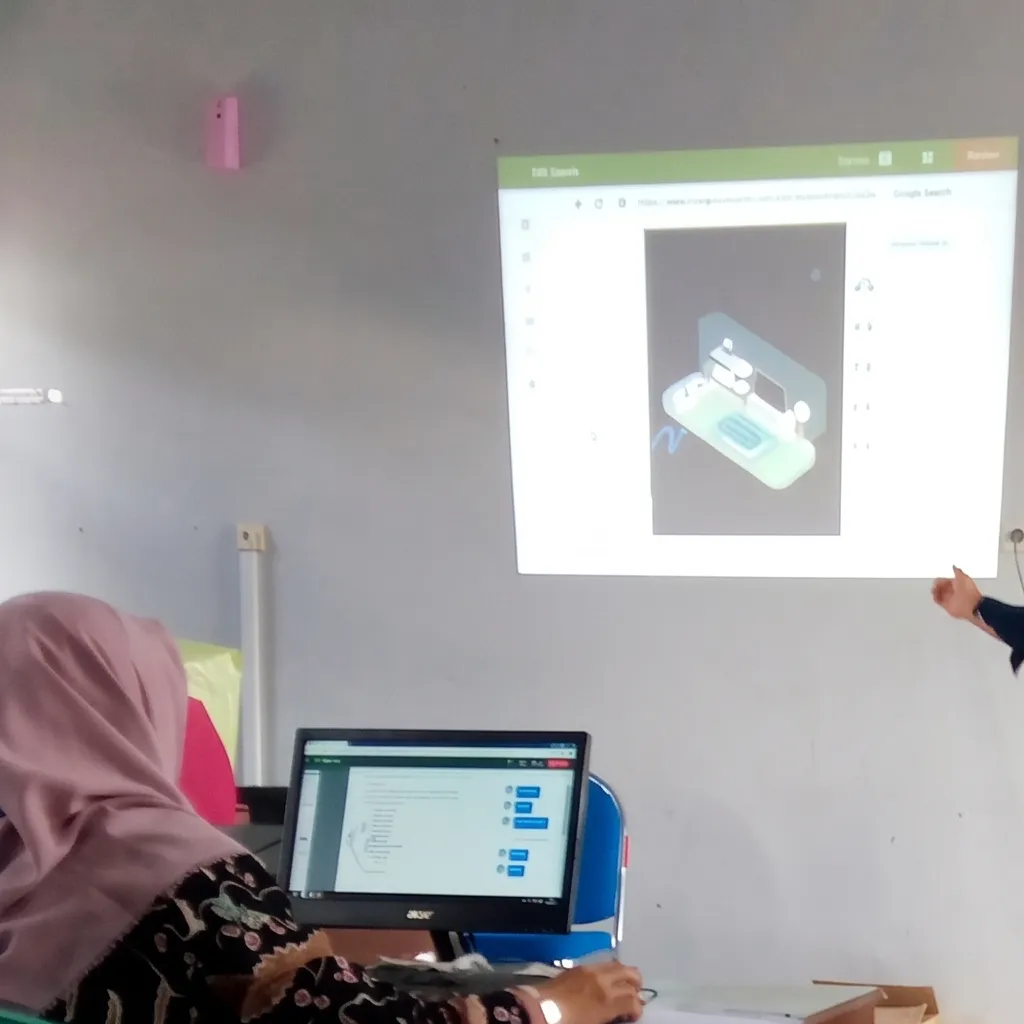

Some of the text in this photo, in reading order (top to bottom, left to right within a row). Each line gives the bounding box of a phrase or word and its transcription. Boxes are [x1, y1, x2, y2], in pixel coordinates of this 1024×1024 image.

[893, 188, 952, 200] Google Search
[406, 909, 435, 920] acer
